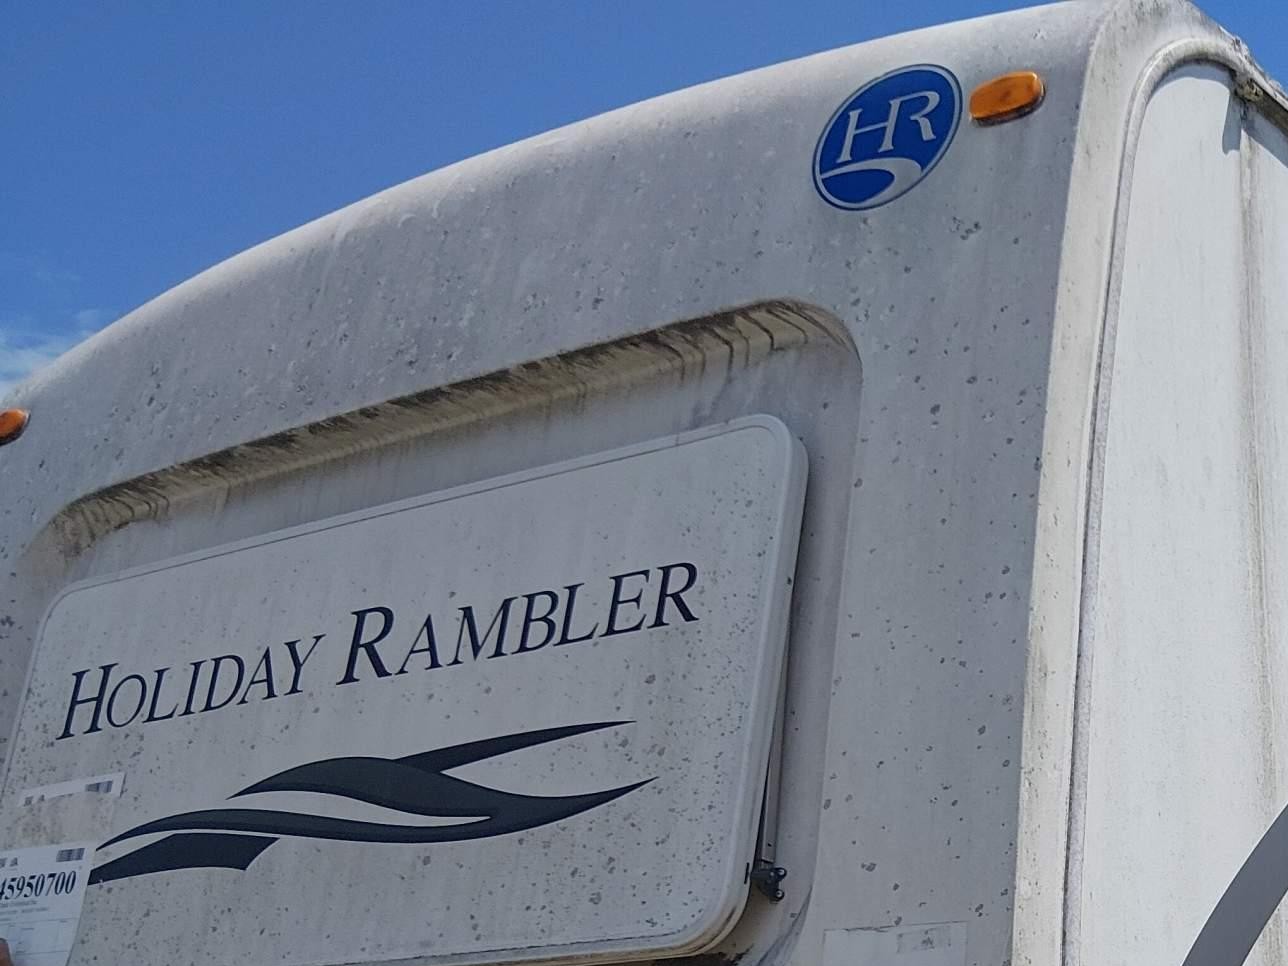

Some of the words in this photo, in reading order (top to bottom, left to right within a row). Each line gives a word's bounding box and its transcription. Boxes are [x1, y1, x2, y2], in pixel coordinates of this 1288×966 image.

[836, 91, 941, 164] HR
[56, 634, 326, 741] HOLIDAY
[336, 562, 700, 687] RAMBLER
